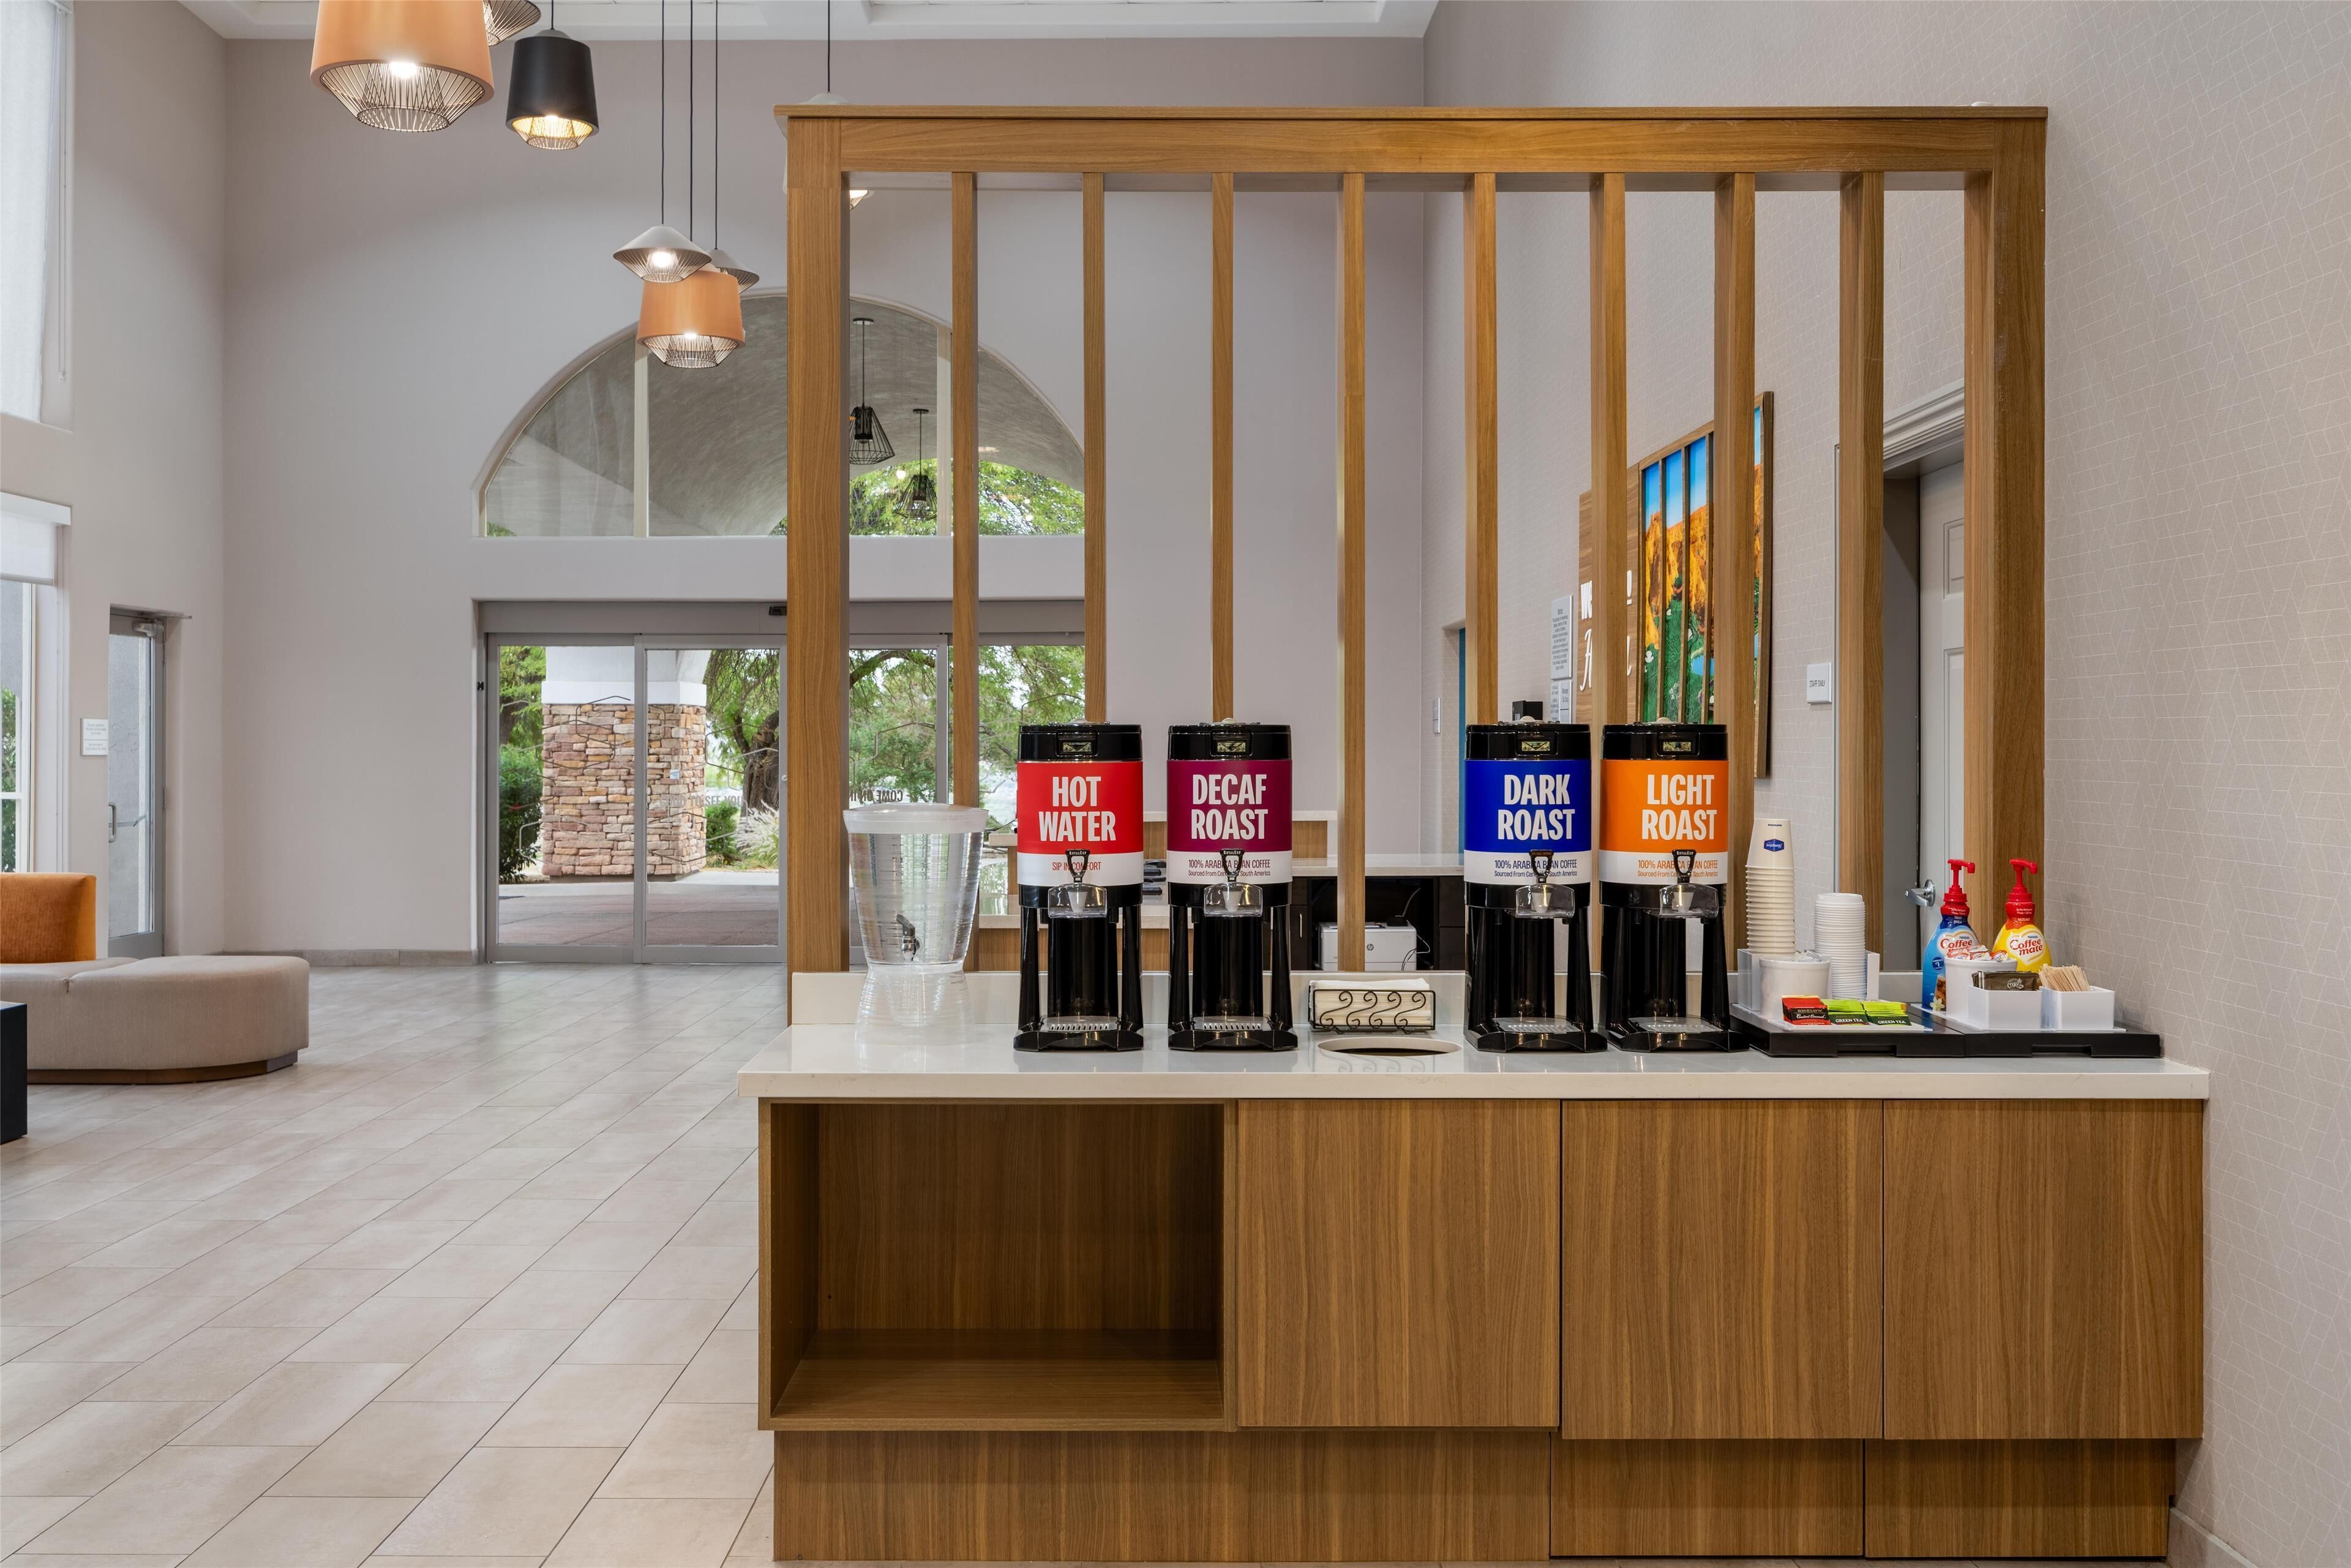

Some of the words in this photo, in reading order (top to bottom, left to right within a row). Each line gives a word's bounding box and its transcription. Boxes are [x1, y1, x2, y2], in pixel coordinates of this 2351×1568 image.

[1052, 776, 1101, 807] HOT
[1193, 774, 1267, 805] DECAF
[1504, 774, 1570, 805] DARK
[1647, 774, 1714, 805] LIGHT
[705, 796, 721, 807] SEE
[1038, 811, 1116, 842] WATER
[1191, 809, 1268, 840] ROAST
[1498, 809, 1575, 840] ROAST
[1642, 809, 1717, 840] ROAST
[1052, 862, 1062, 871] SIP
[1188, 859, 1204, 868] 100%
[1205, 860, 1232, 868] ARABA
[1234, 860, 1250, 868] BAN
[1252, 859, 1270, 868] COFFEE
[1494, 860, 1511, 869] 100%
[1513, 860, 1541, 869] ARABA
[1543, 860, 1558, 869] BAN
[1560, 859, 1577, 868] COFFEE
[1638, 860, 1655, 869] 100%
[1703, 860, 1718, 869] COFFEE
[1940, 938, 1973, 949] Coffee
[2009, 939, 2041, 950] Coffee
[2019, 944, 2043, 956] mate
